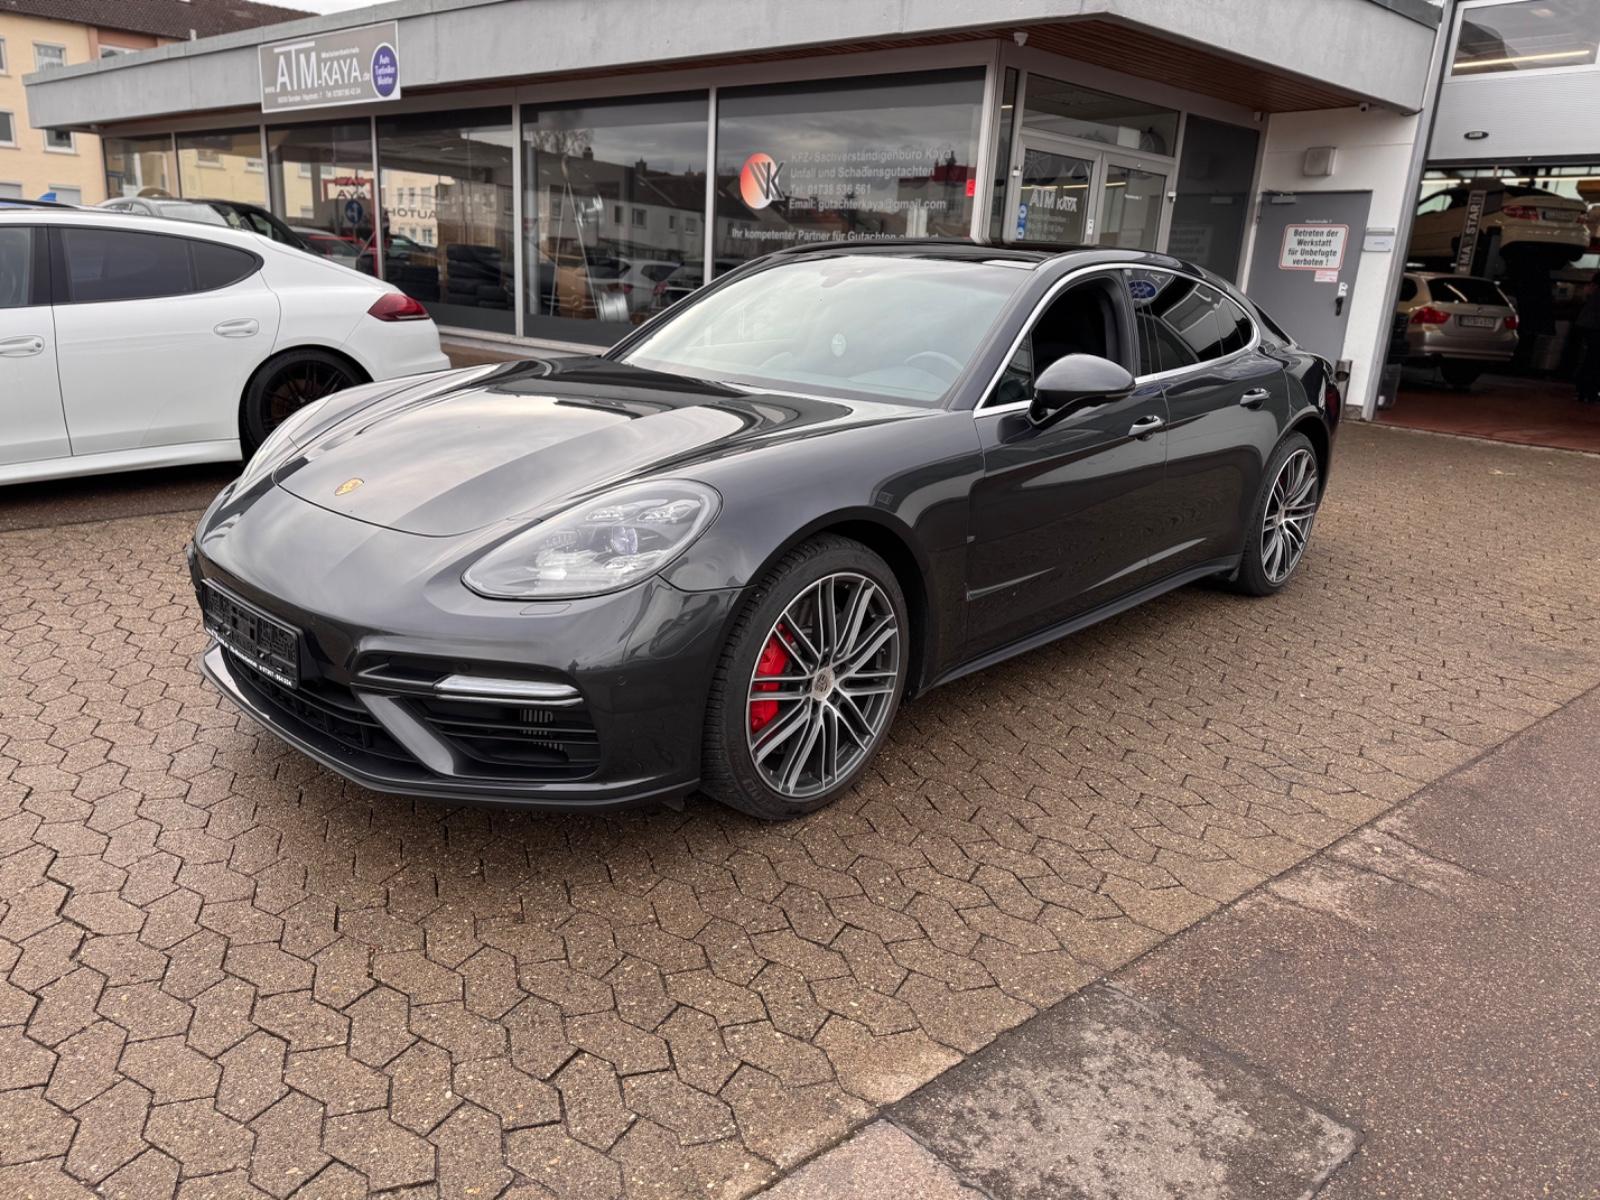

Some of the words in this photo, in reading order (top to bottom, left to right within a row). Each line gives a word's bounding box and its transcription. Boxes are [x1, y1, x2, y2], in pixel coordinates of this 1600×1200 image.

[820, 168, 836, 178] und
[798, 230, 829, 240] Partner
[832, 230, 845, 240] für
[1294, 229, 1324, 237] Betreten
[1326, 229, 1339, 237] der
[1288, 248, 1299, 256] für
[1300, 248, 1337, 257] Unbefugte
